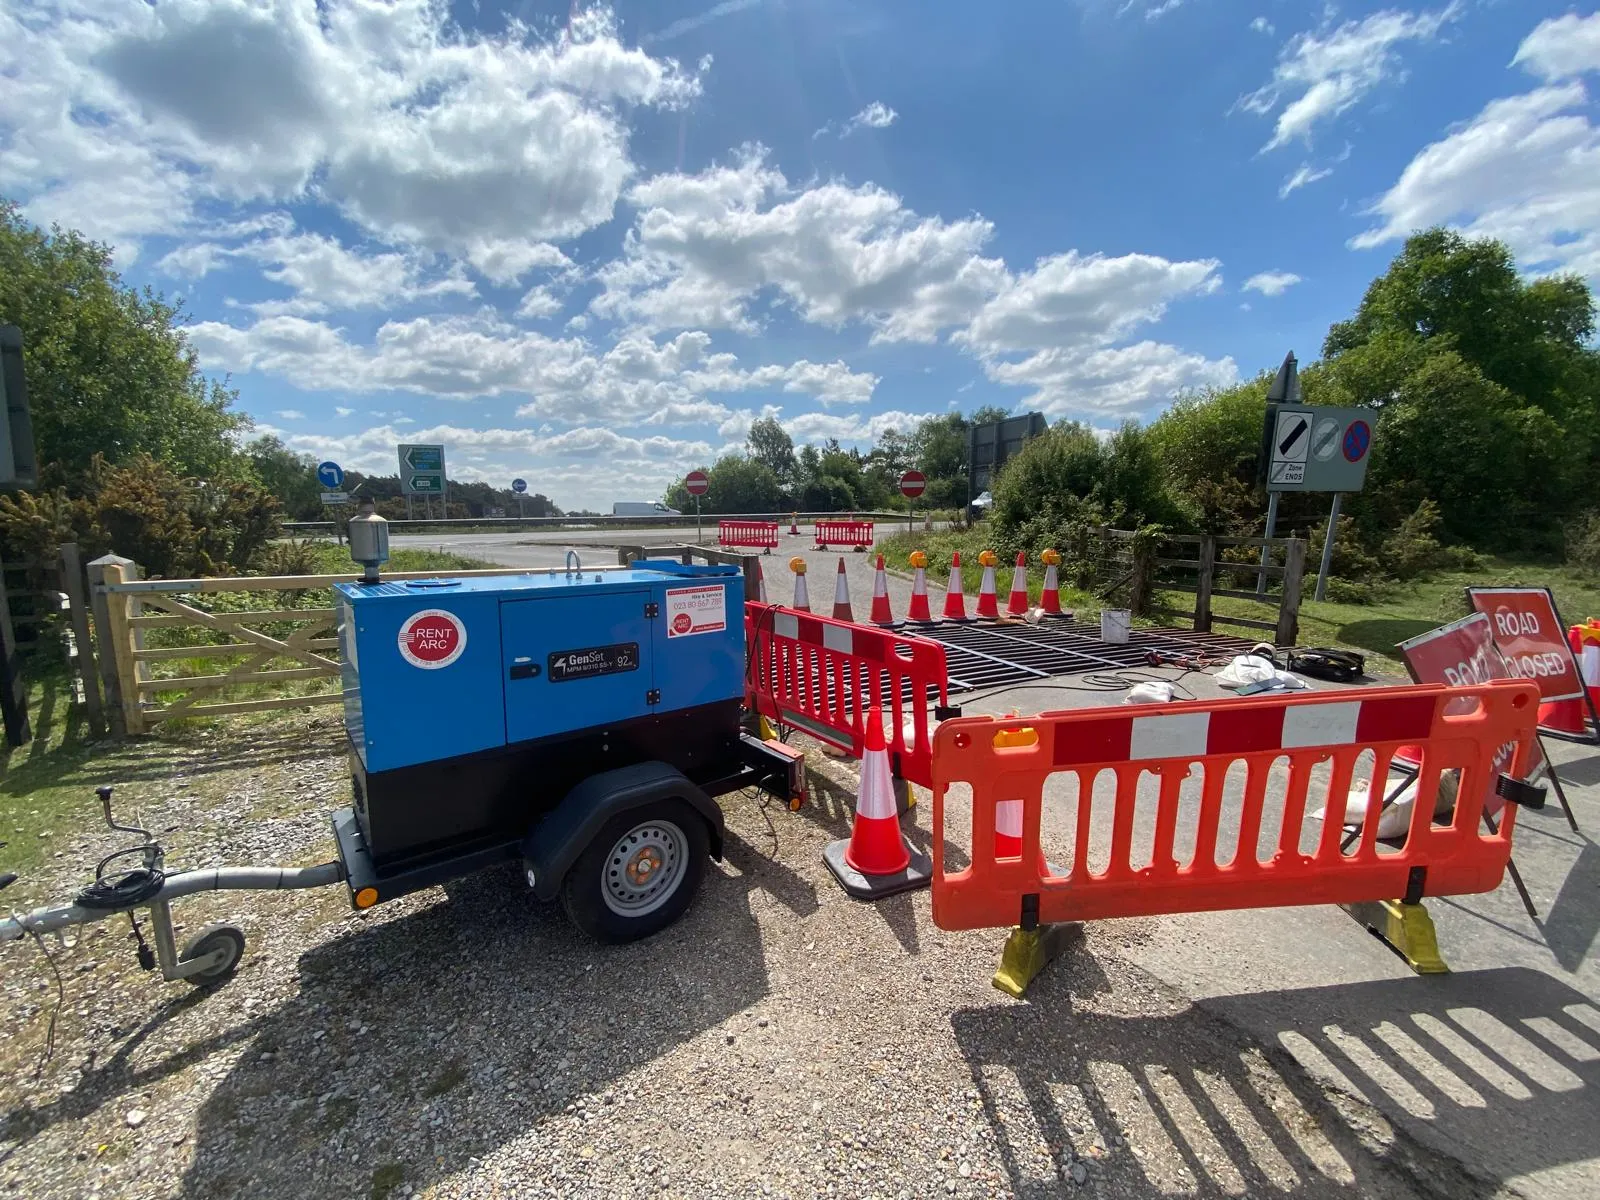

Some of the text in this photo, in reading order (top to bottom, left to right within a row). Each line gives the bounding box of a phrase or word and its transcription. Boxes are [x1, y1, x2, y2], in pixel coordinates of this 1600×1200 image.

[1288, 463, 1302, 471] Zone
[1494, 612, 1540, 636] ROAD
[416, 628, 452, 638] RENT
[419, 639, 447, 649] ARC
[568, 651, 604, 665] GenSet
[617, 655, 628, 667] 92
[1505, 652, 1566, 679] CLOSED
